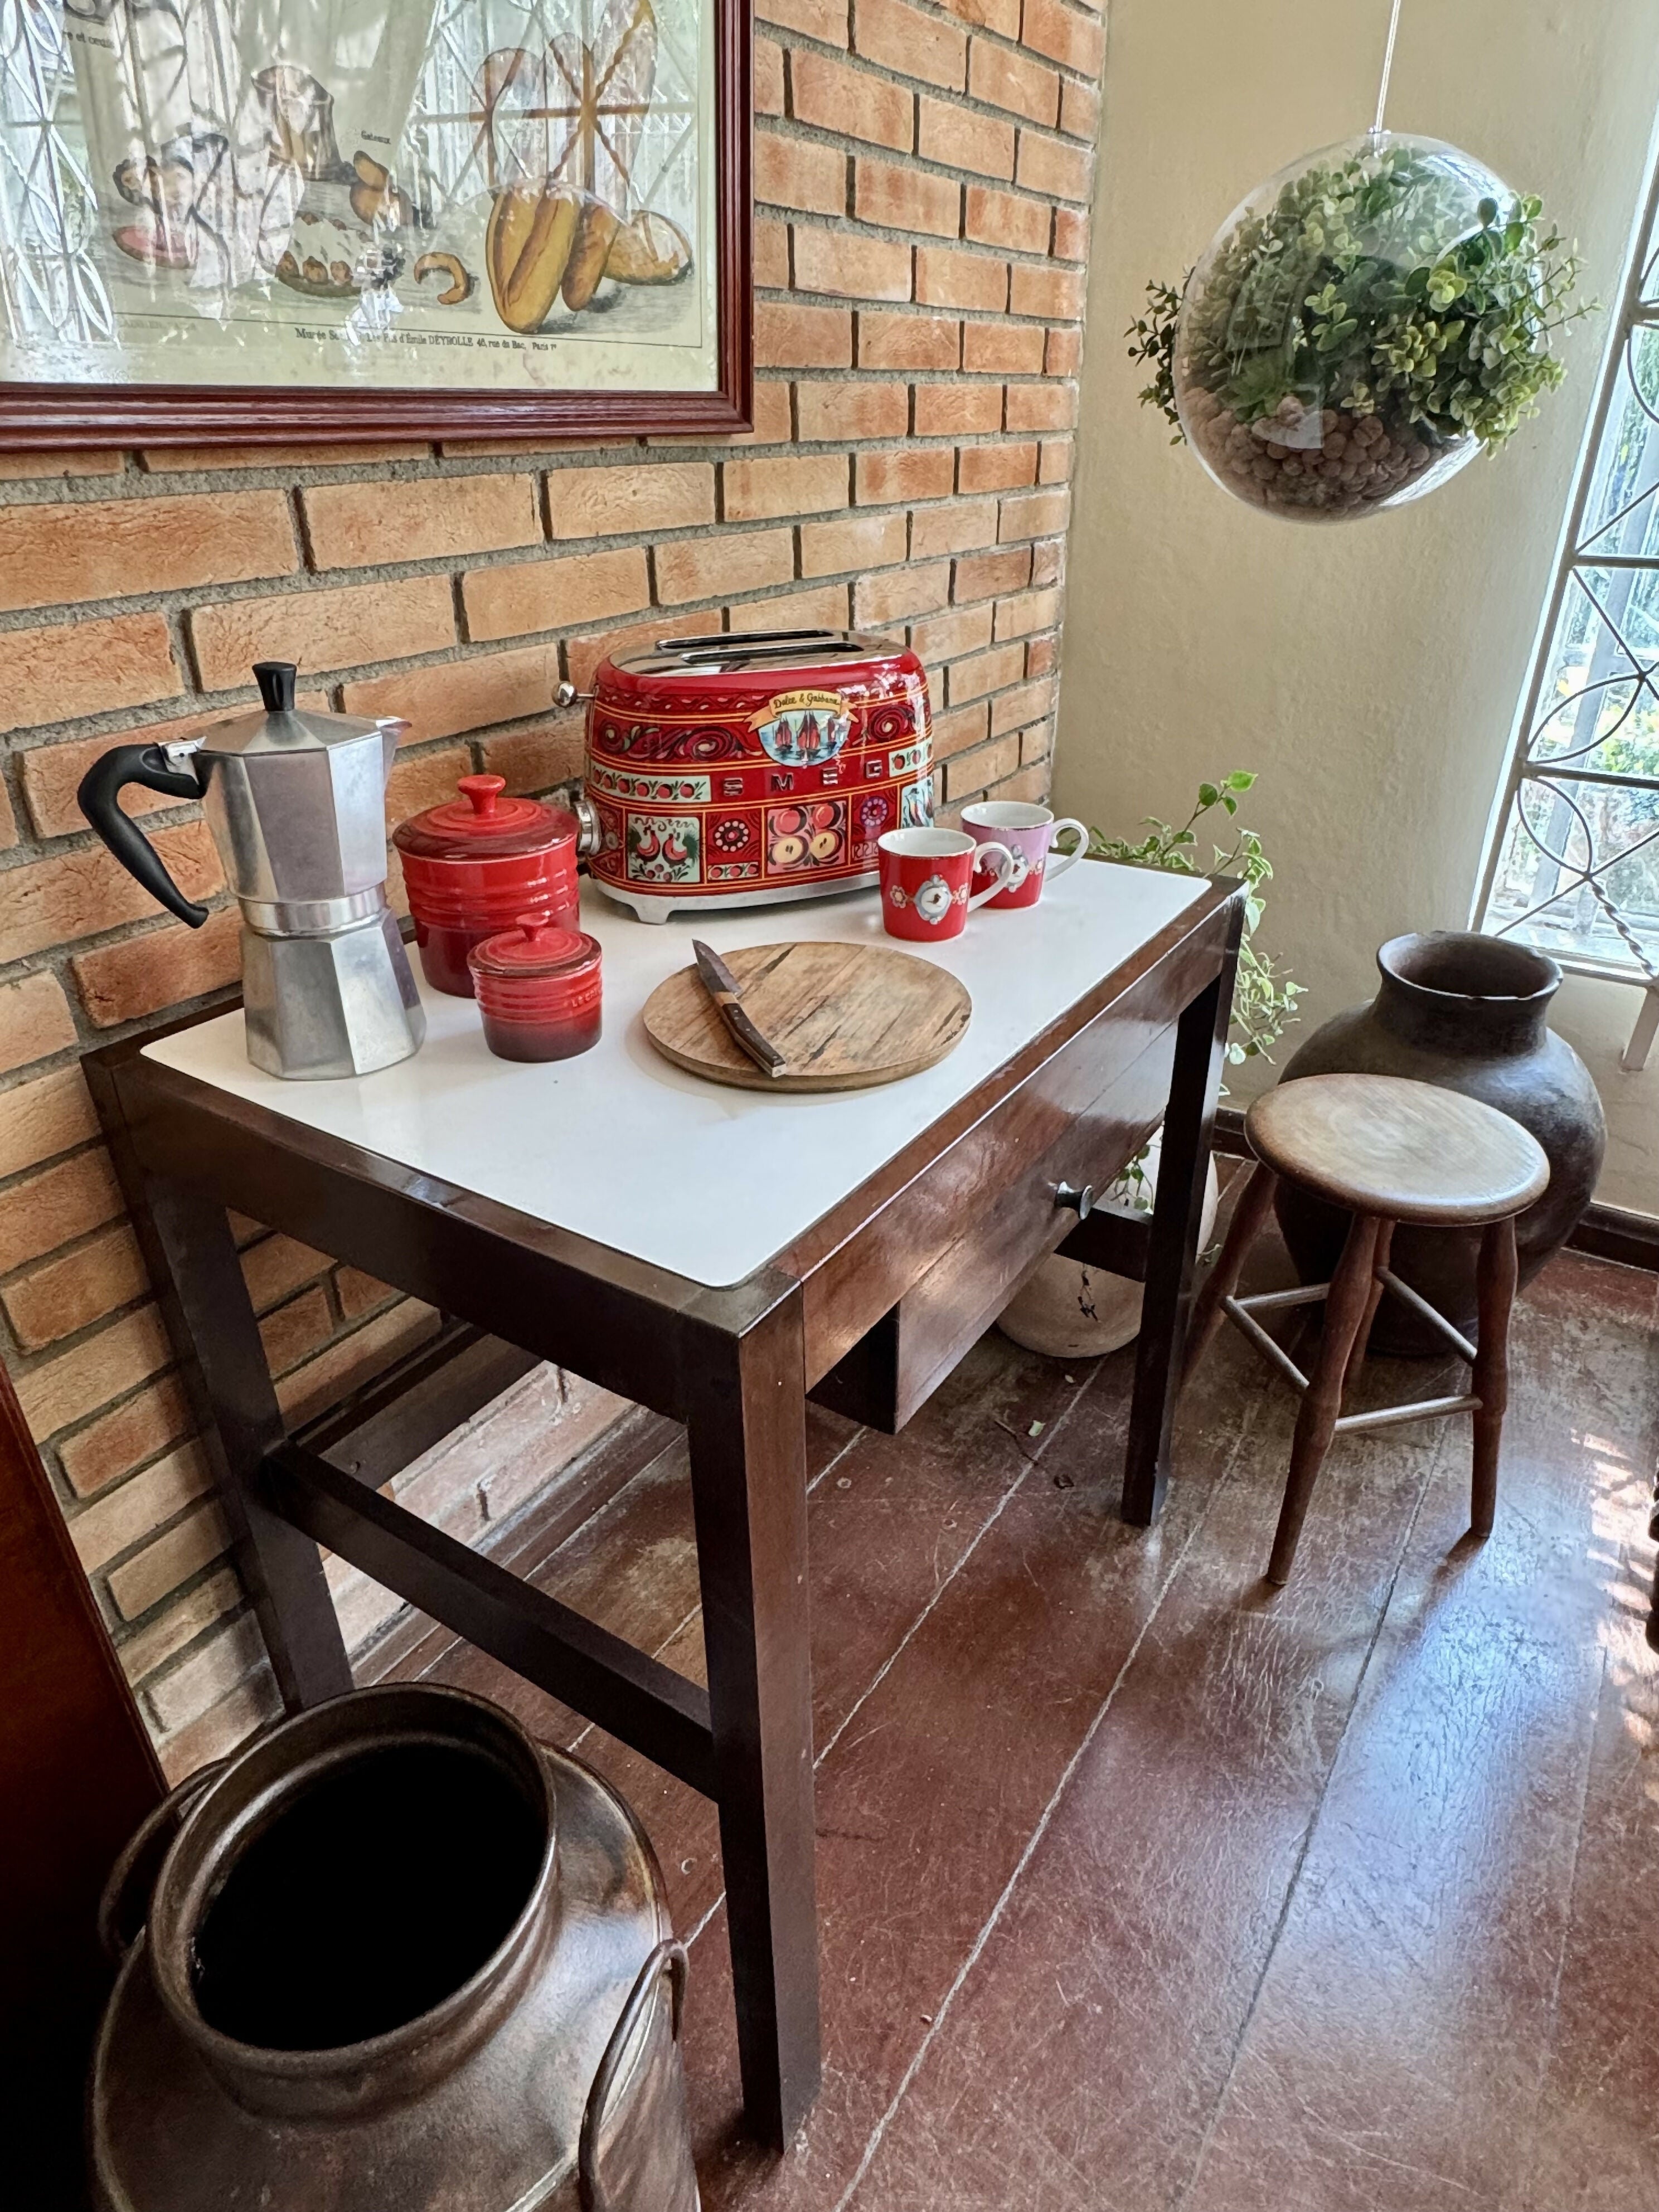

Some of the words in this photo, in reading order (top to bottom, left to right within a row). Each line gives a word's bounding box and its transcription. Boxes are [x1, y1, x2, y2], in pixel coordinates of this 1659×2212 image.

[774, 694, 797, 709] Dolce
[806, 692, 840, 707] Gabbana
[724, 760, 882, 796] SMEG
